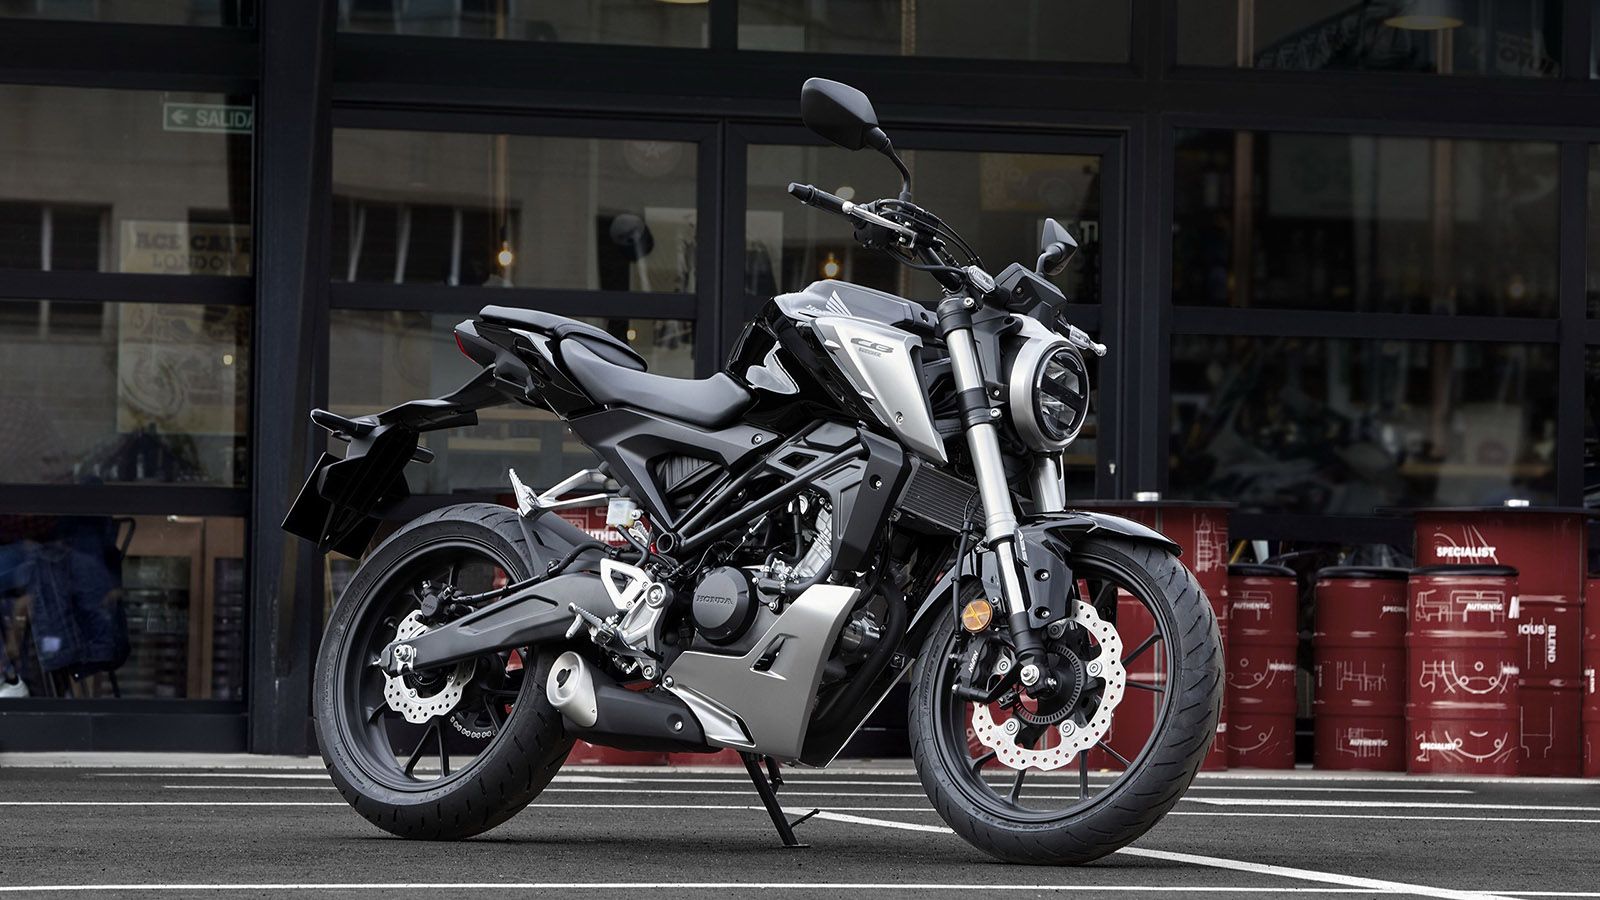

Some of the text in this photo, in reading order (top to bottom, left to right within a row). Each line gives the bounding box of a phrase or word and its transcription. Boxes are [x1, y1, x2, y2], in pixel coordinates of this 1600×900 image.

[1436, 546, 1496, 558] SPECIALIST
[696, 594, 733, 605] HONDA
[1232, 602, 1271, 611] AUTHENTIC
[1465, 603, 1503, 612] AUTHENTIC
[1547, 624, 1557, 664] BLEND
[1349, 739, 1389, 747] AUTHENTIC
